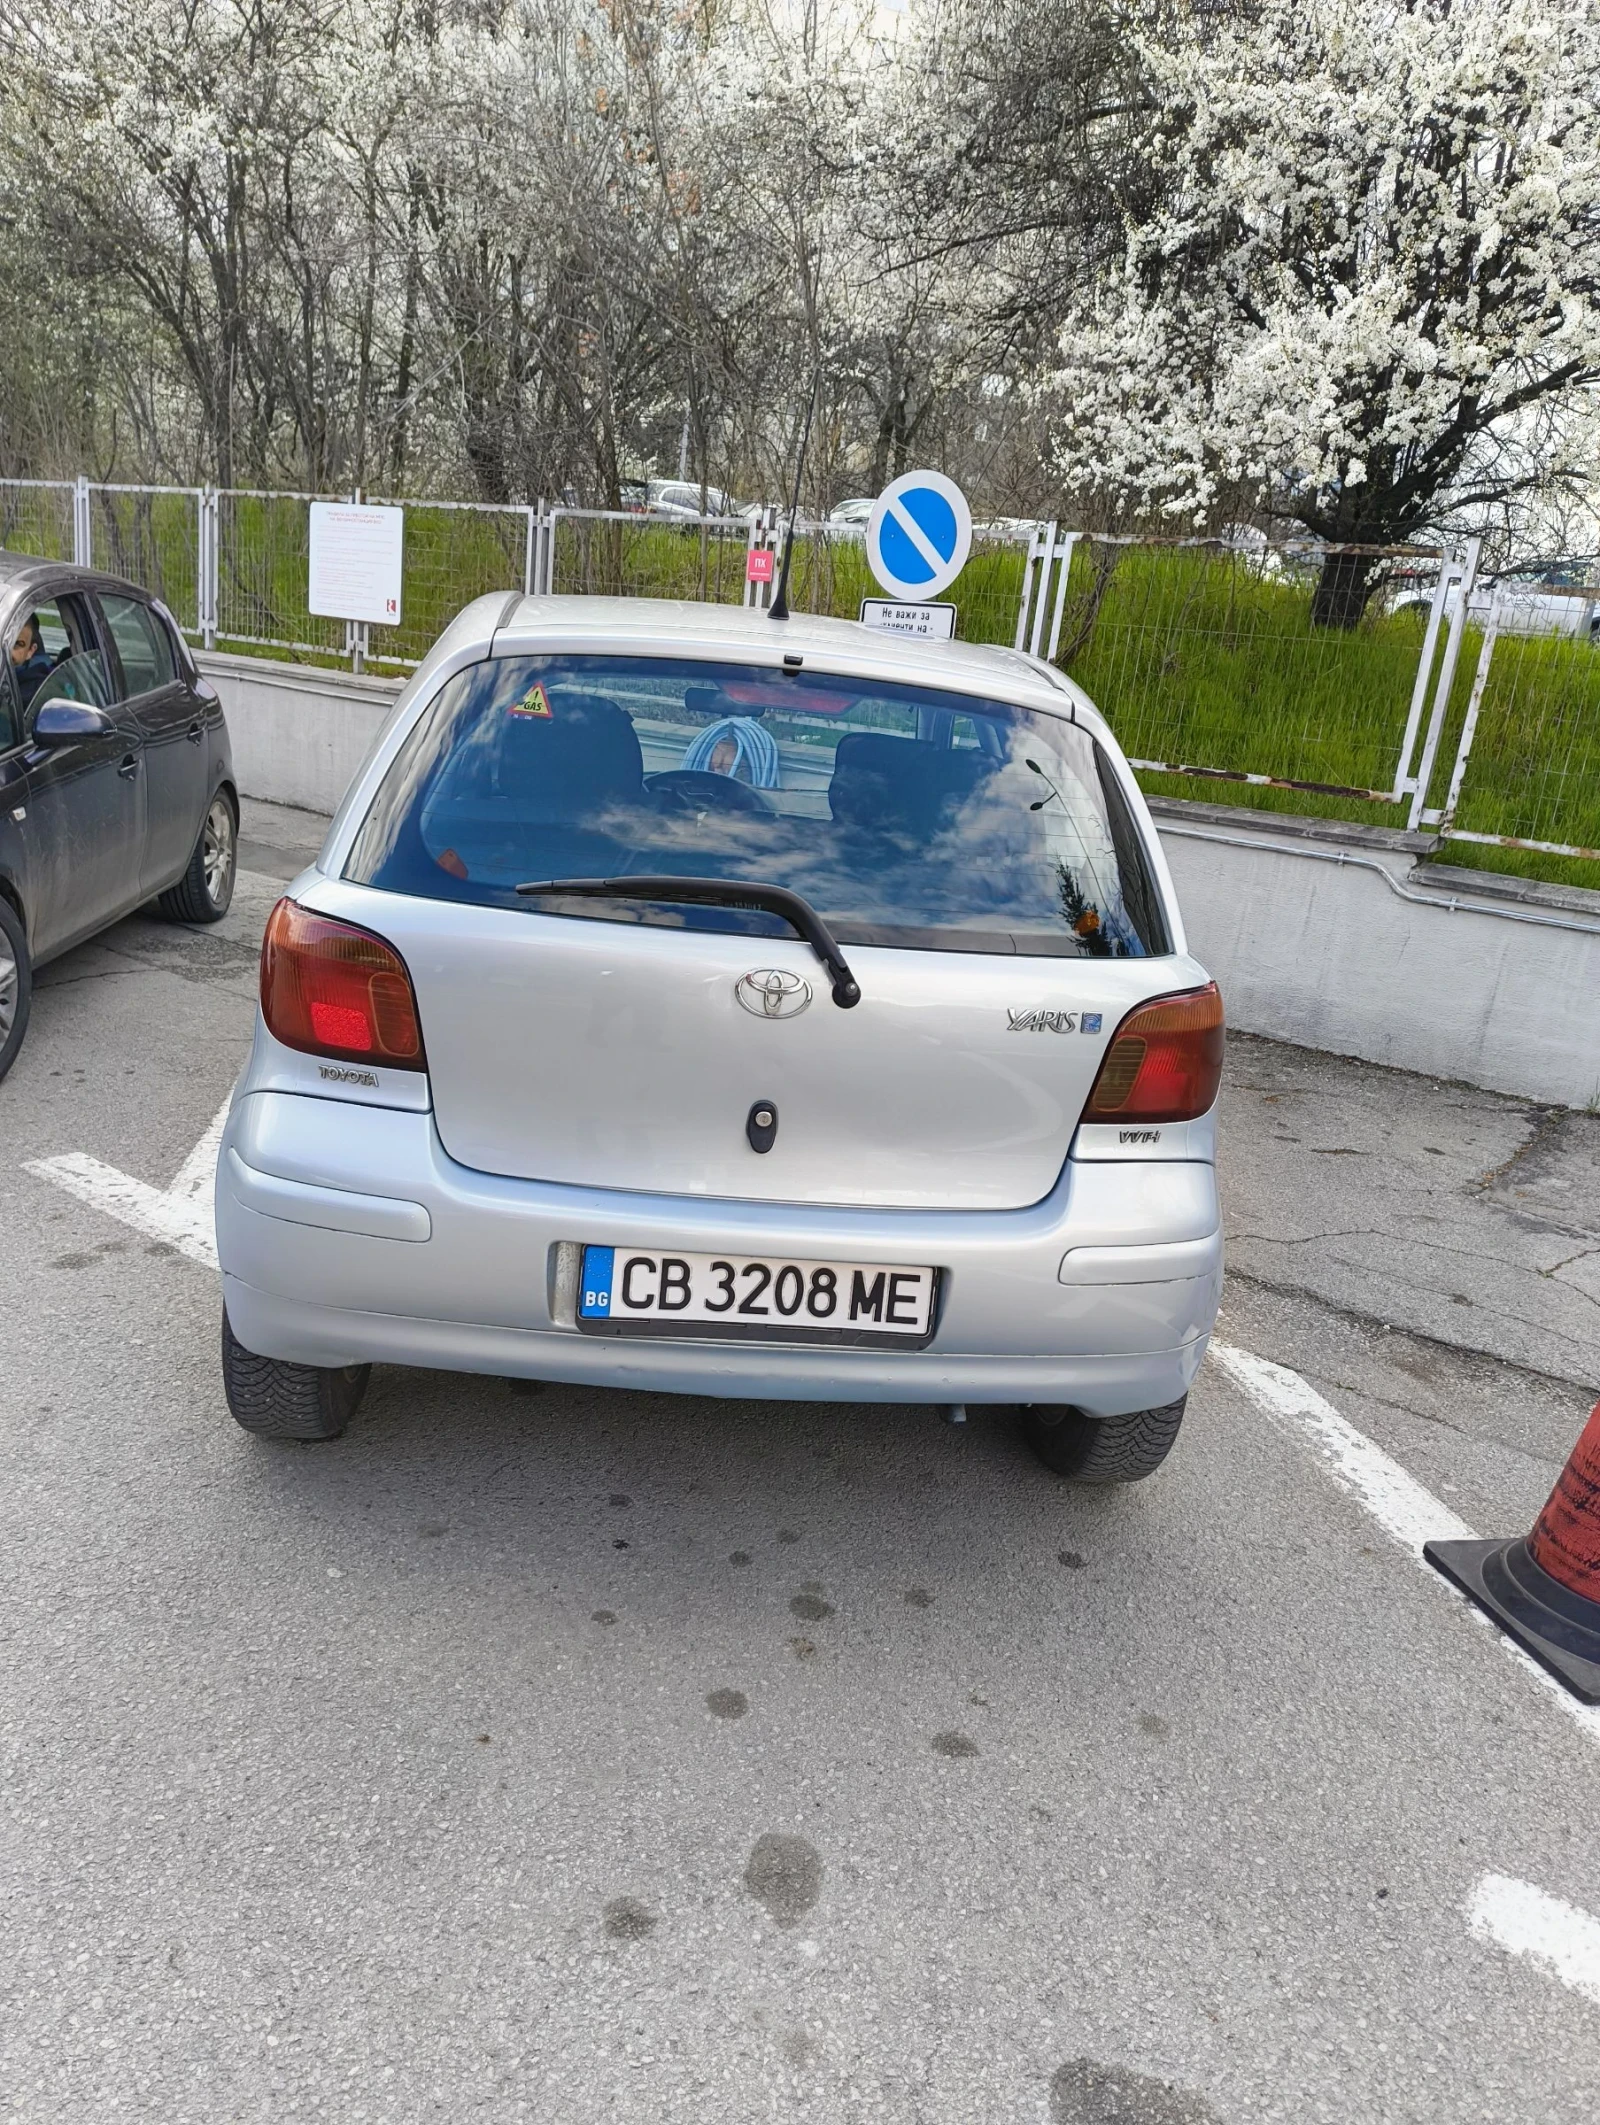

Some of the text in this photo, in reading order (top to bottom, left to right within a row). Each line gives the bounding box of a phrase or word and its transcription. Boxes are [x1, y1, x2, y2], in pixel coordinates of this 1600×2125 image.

[882, 607, 930, 621] Не важи за
[917, 625, 928, 633] на
[523, 701, 543, 711] GAS
[318, 1064, 379, 1088] TOYOTA
[585, 1290, 608, 1307] BG
[622, 1257, 921, 1325] CB 3208 ME
